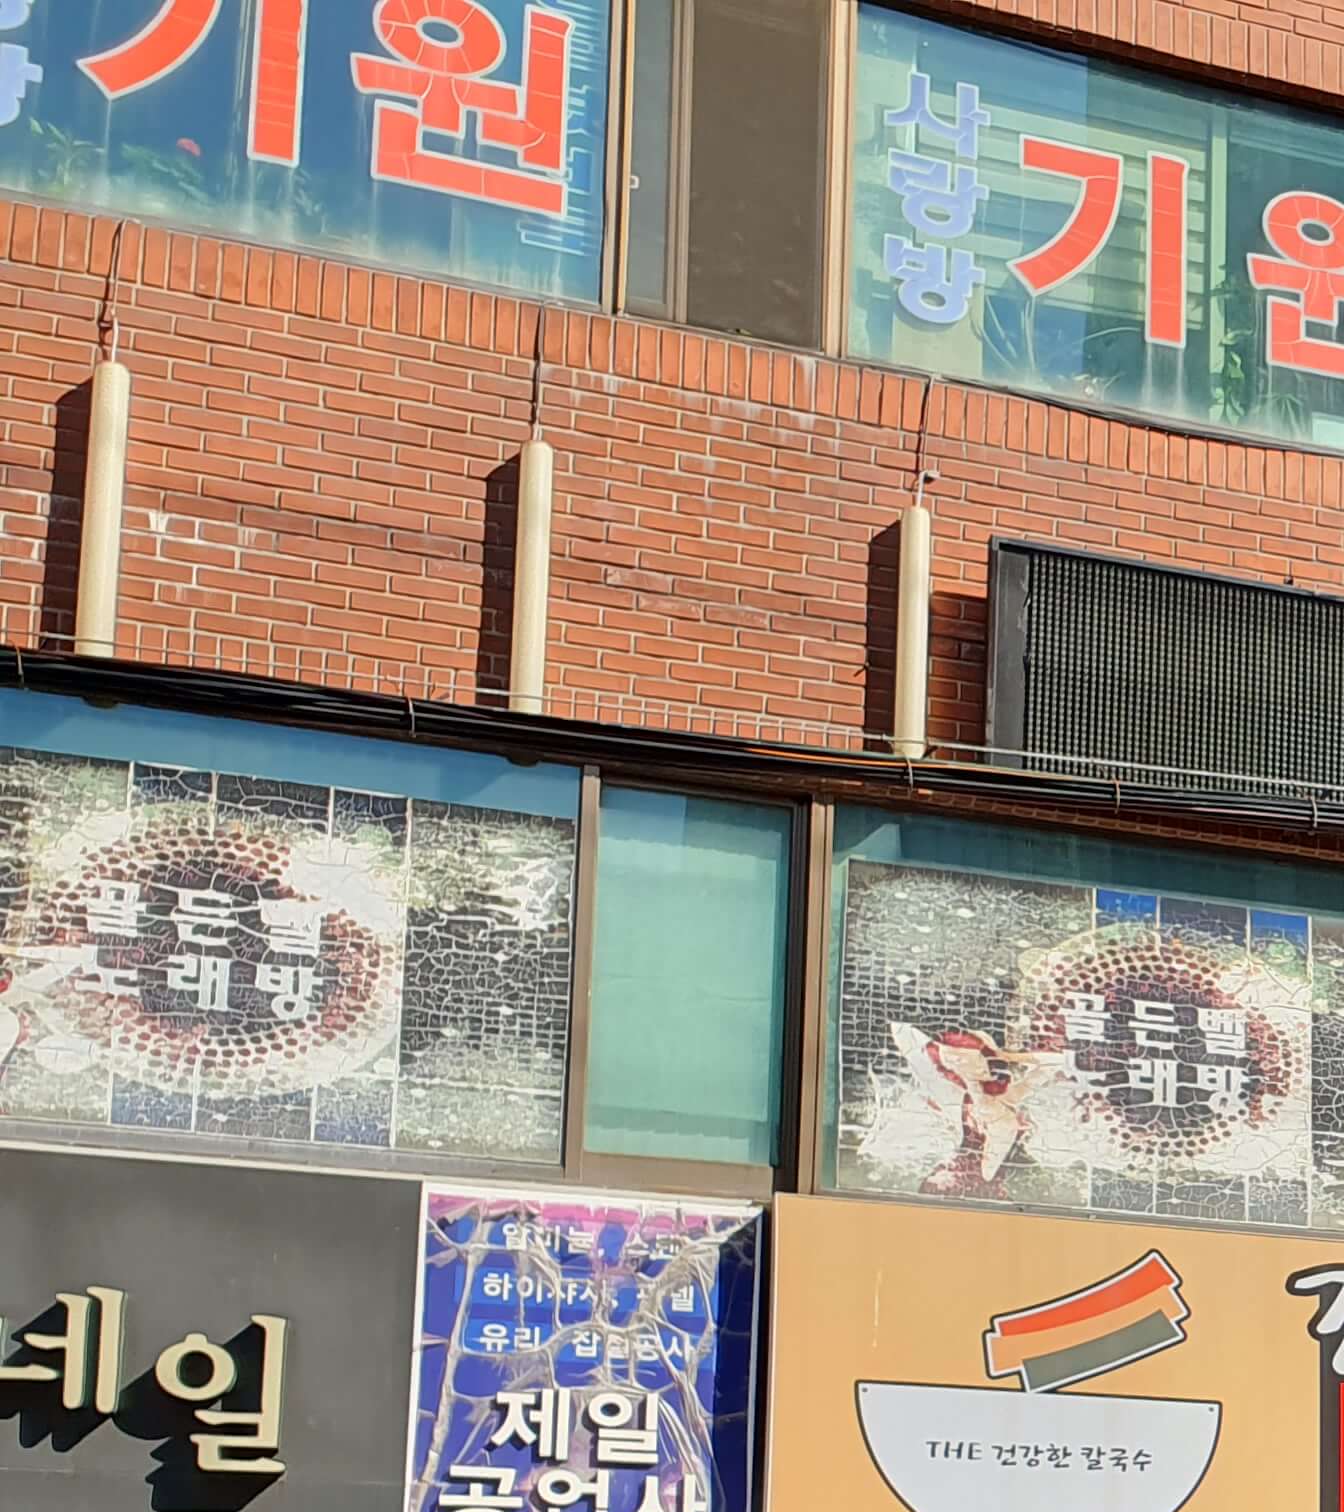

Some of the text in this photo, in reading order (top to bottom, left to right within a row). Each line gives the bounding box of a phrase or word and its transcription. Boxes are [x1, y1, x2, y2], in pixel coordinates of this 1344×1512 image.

[75, 0, 575, 220] 기원
[883, 71, 991, 325] 사랑방
[479, 1322, 542, 1353] 유리
[490, 1386, 661, 1465] 제일
[925, 1440, 1153, 1473] THE 건강한 칼국수
